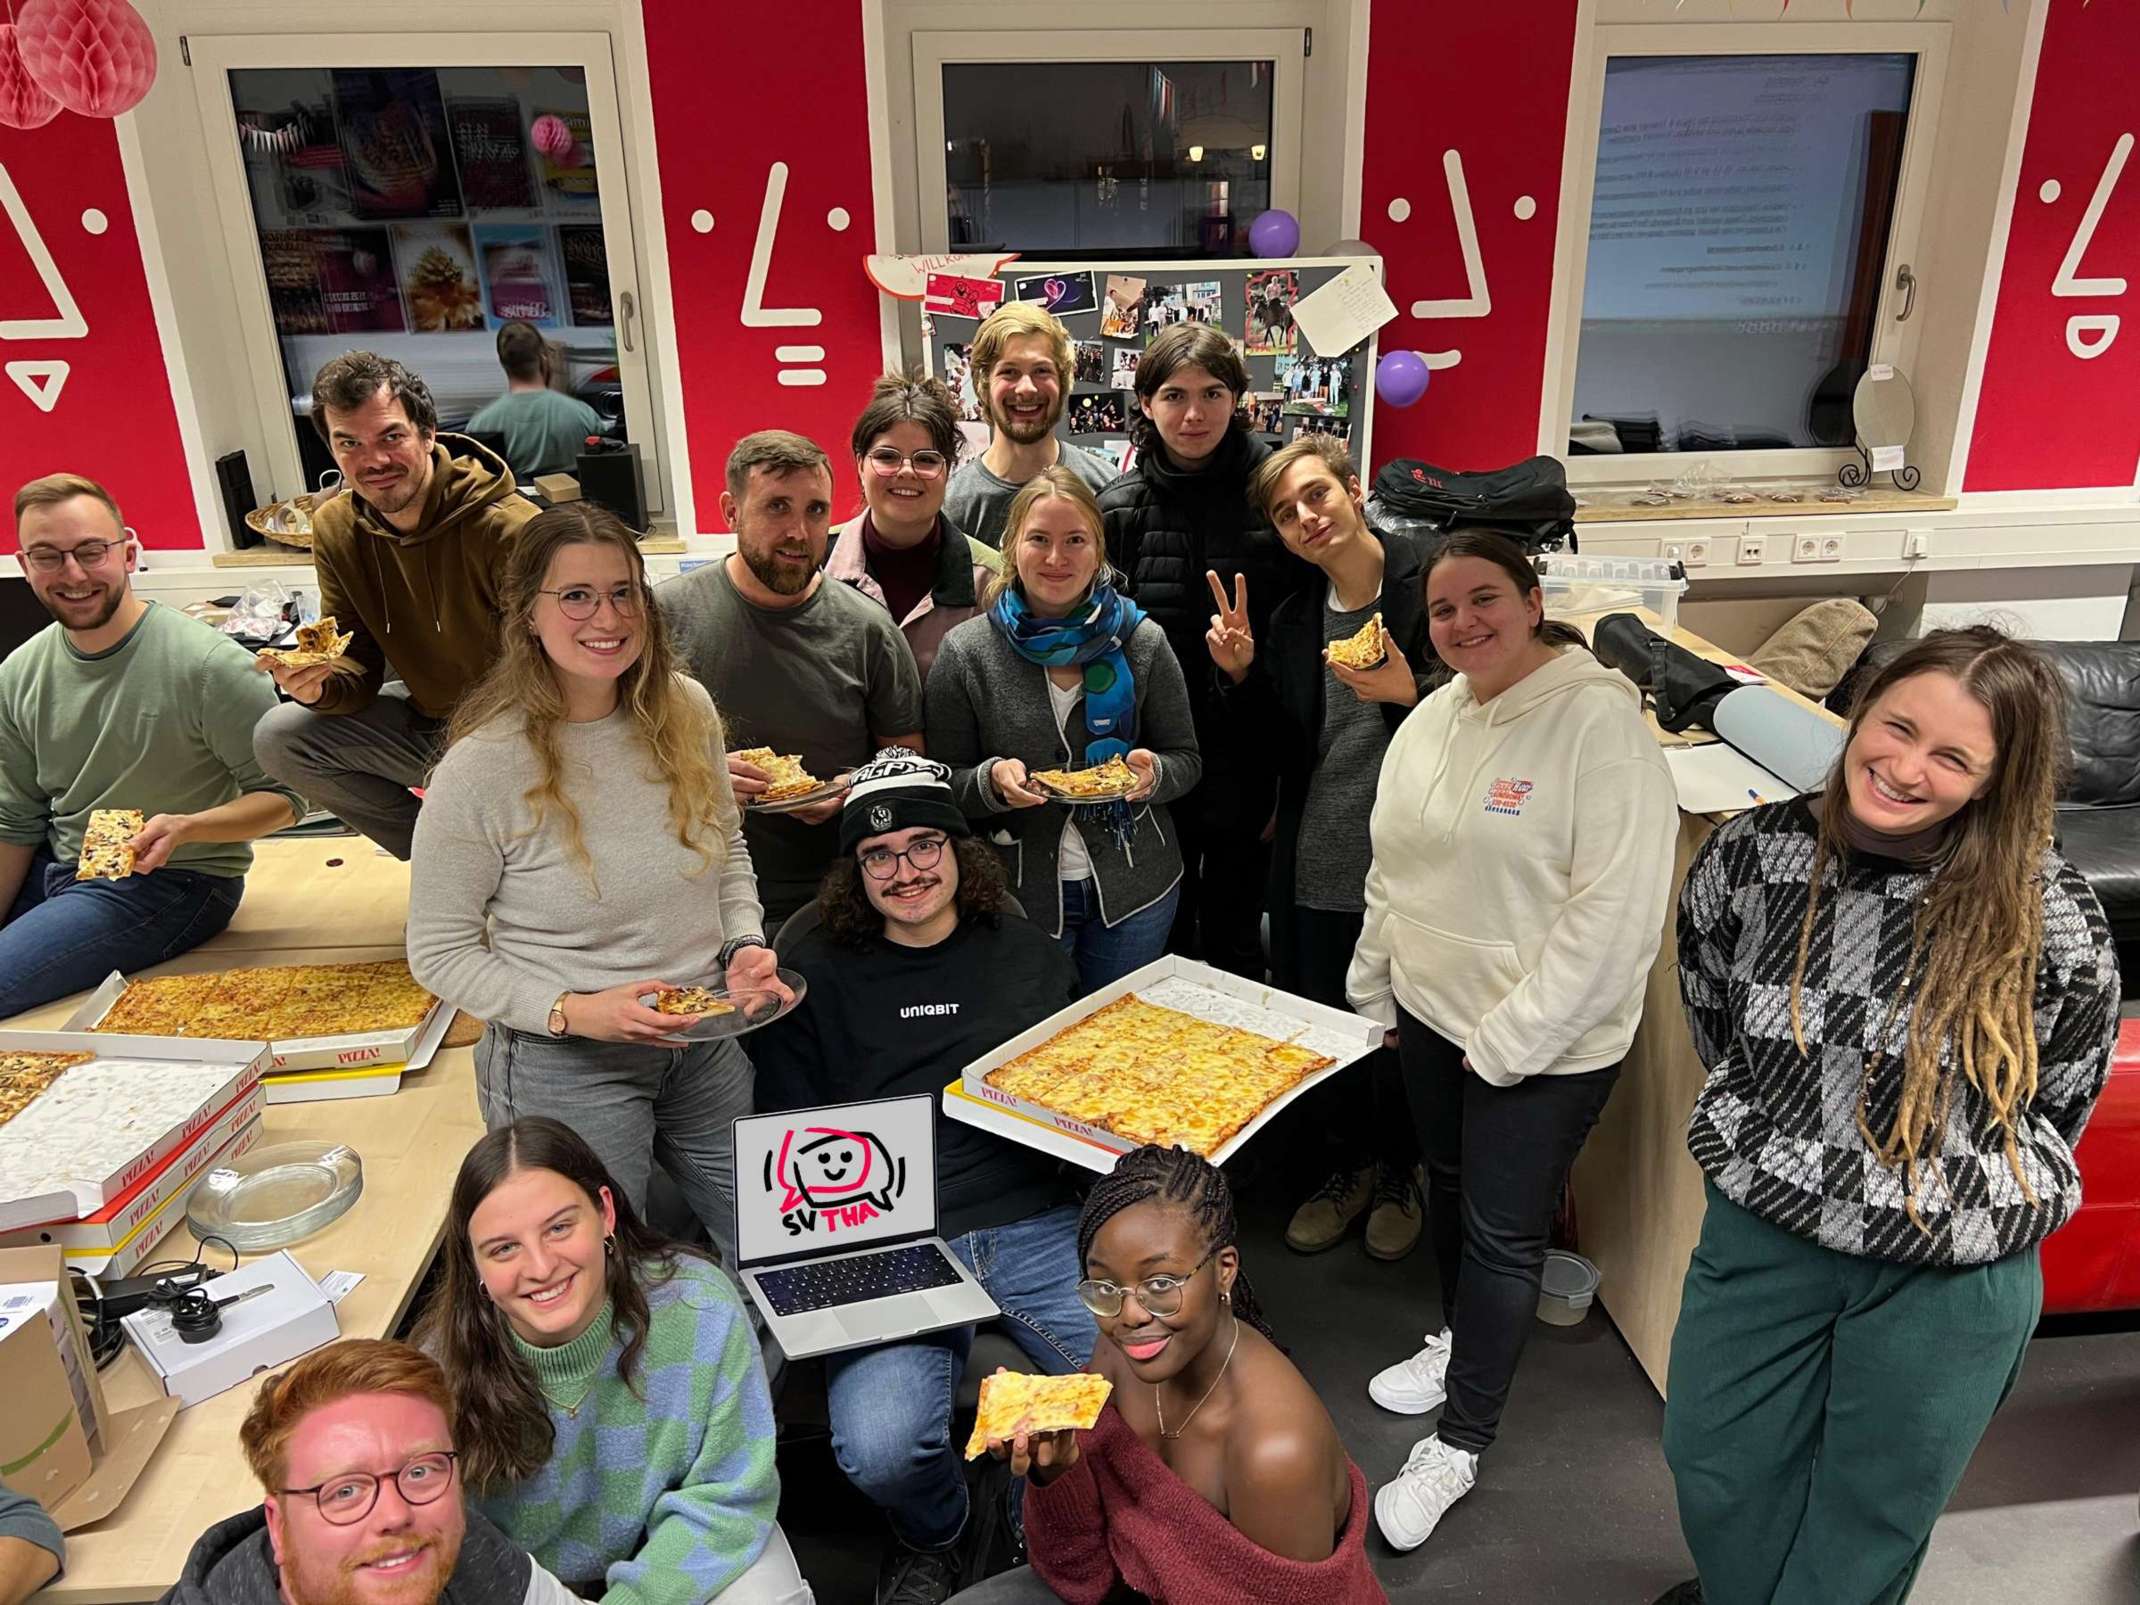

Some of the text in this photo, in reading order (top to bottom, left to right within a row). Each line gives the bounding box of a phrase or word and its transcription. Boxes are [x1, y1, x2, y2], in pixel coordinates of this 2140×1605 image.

[336, 1048, 381, 1065] PIZZA!
[121, 1060, 261, 1188] PIZZA! PIZZA! PIZZA!
[130, 1188, 159, 1227] PIZZA!
[184, 1141, 210, 1177] PIZZA!
[782, 1201, 880, 1236] SV THA
